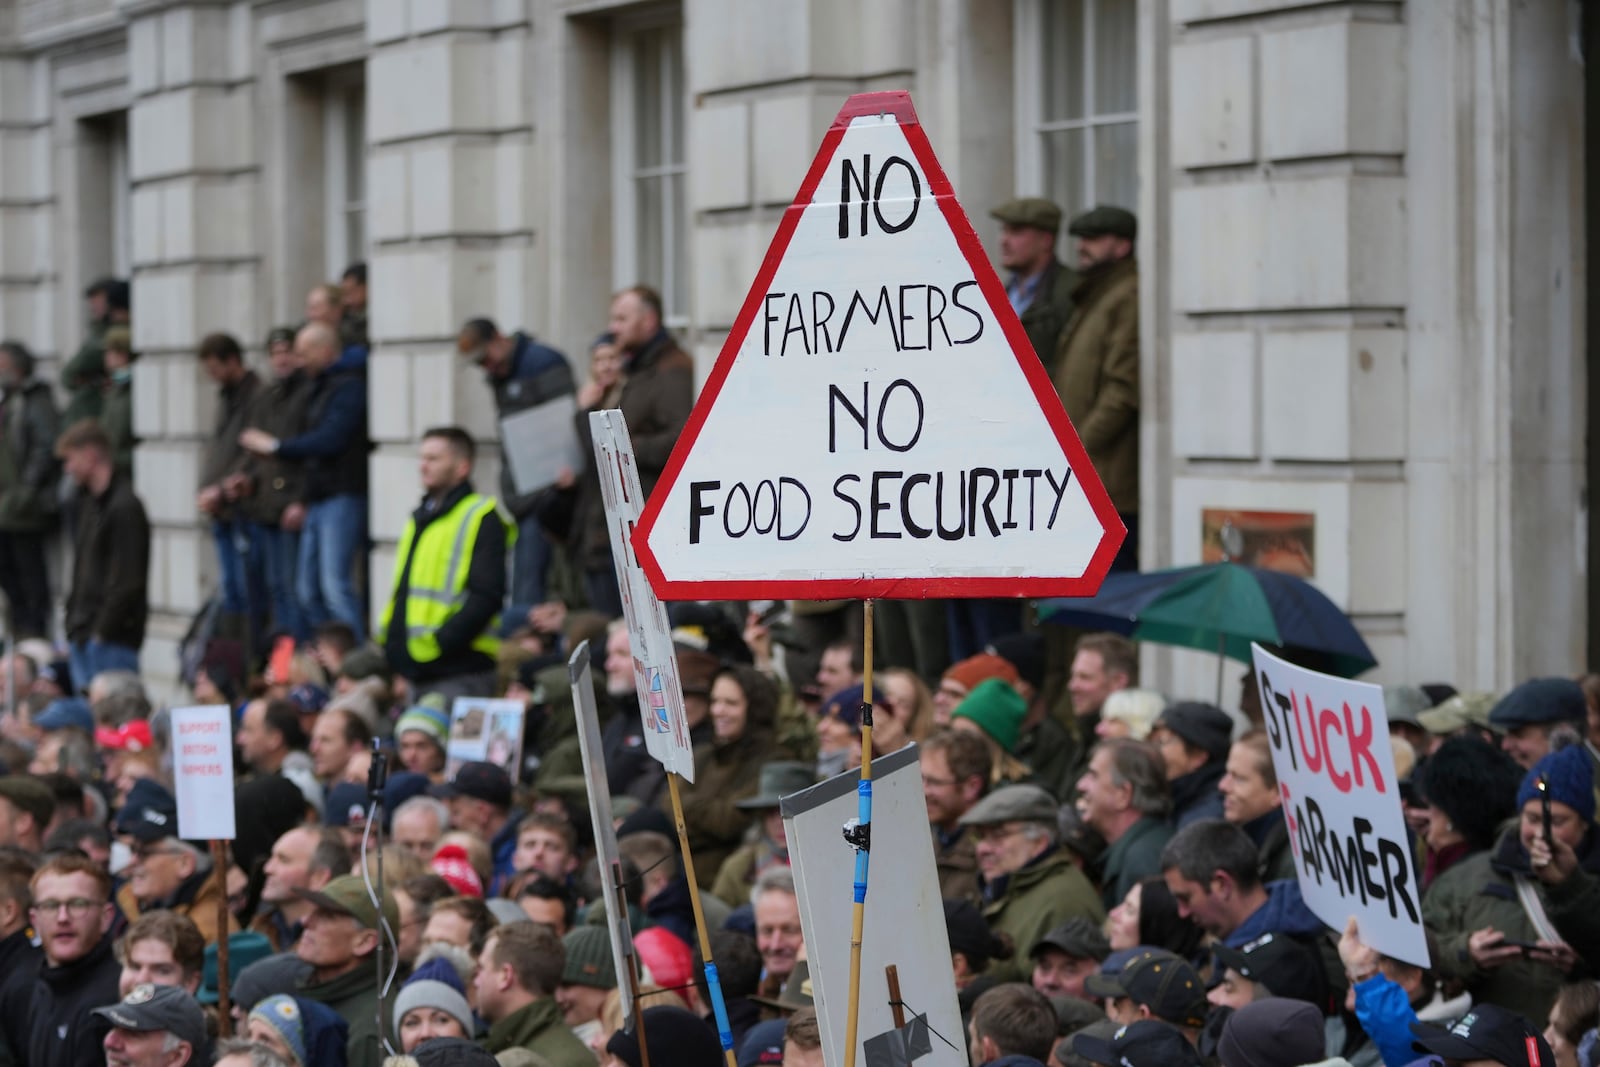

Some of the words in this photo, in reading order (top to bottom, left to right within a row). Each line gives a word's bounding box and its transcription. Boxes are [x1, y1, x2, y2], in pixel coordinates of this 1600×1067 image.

[838, 153, 922, 240] NO
[763, 280, 985, 357] FARMERS
[828, 378, 925, 453] NO
[689, 476, 812, 545] FOOD
[832, 467, 1072, 542] SECURITY
[1261, 669, 1387, 795] STUCK
[1280, 781, 1420, 925] FARMER
